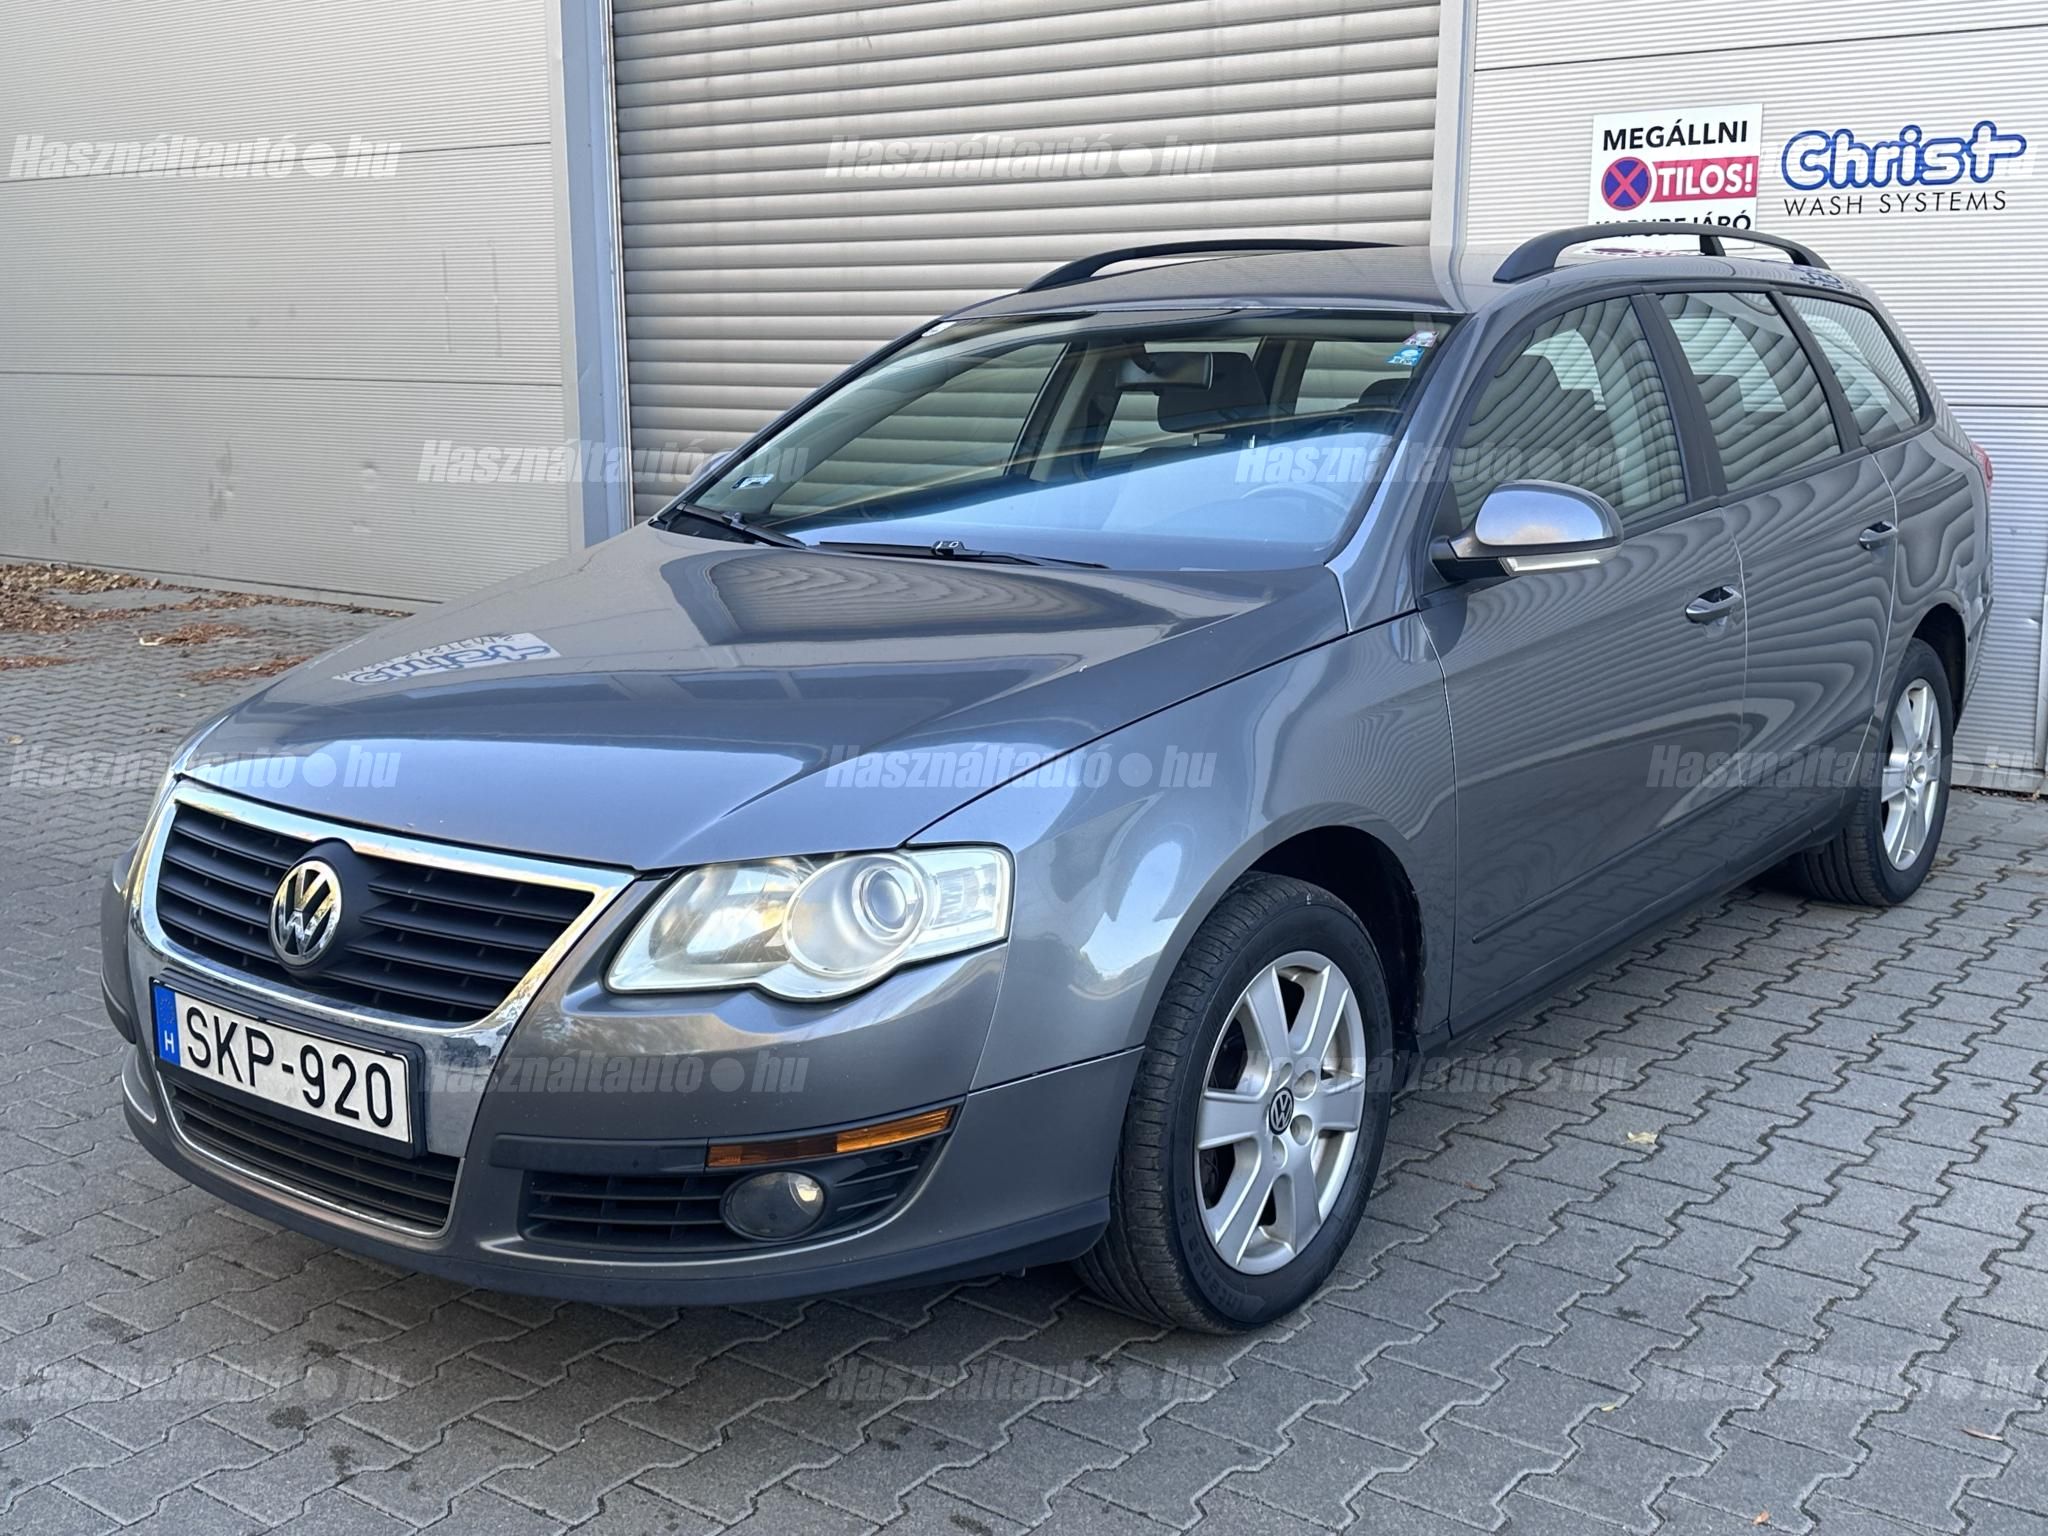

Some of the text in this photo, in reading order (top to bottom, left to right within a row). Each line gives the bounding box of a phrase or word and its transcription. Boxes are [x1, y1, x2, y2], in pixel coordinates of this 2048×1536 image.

[1602, 118, 1748, 151] MEGÁLLNI
[1781, 120, 2027, 190] Christ
[1657, 162, 1754, 196] TILOS!
[1783, 189, 2007, 217] WASH SYSTEMS
[164, 1030, 175, 1054] H
[186, 1005, 393, 1128] SKP-920
